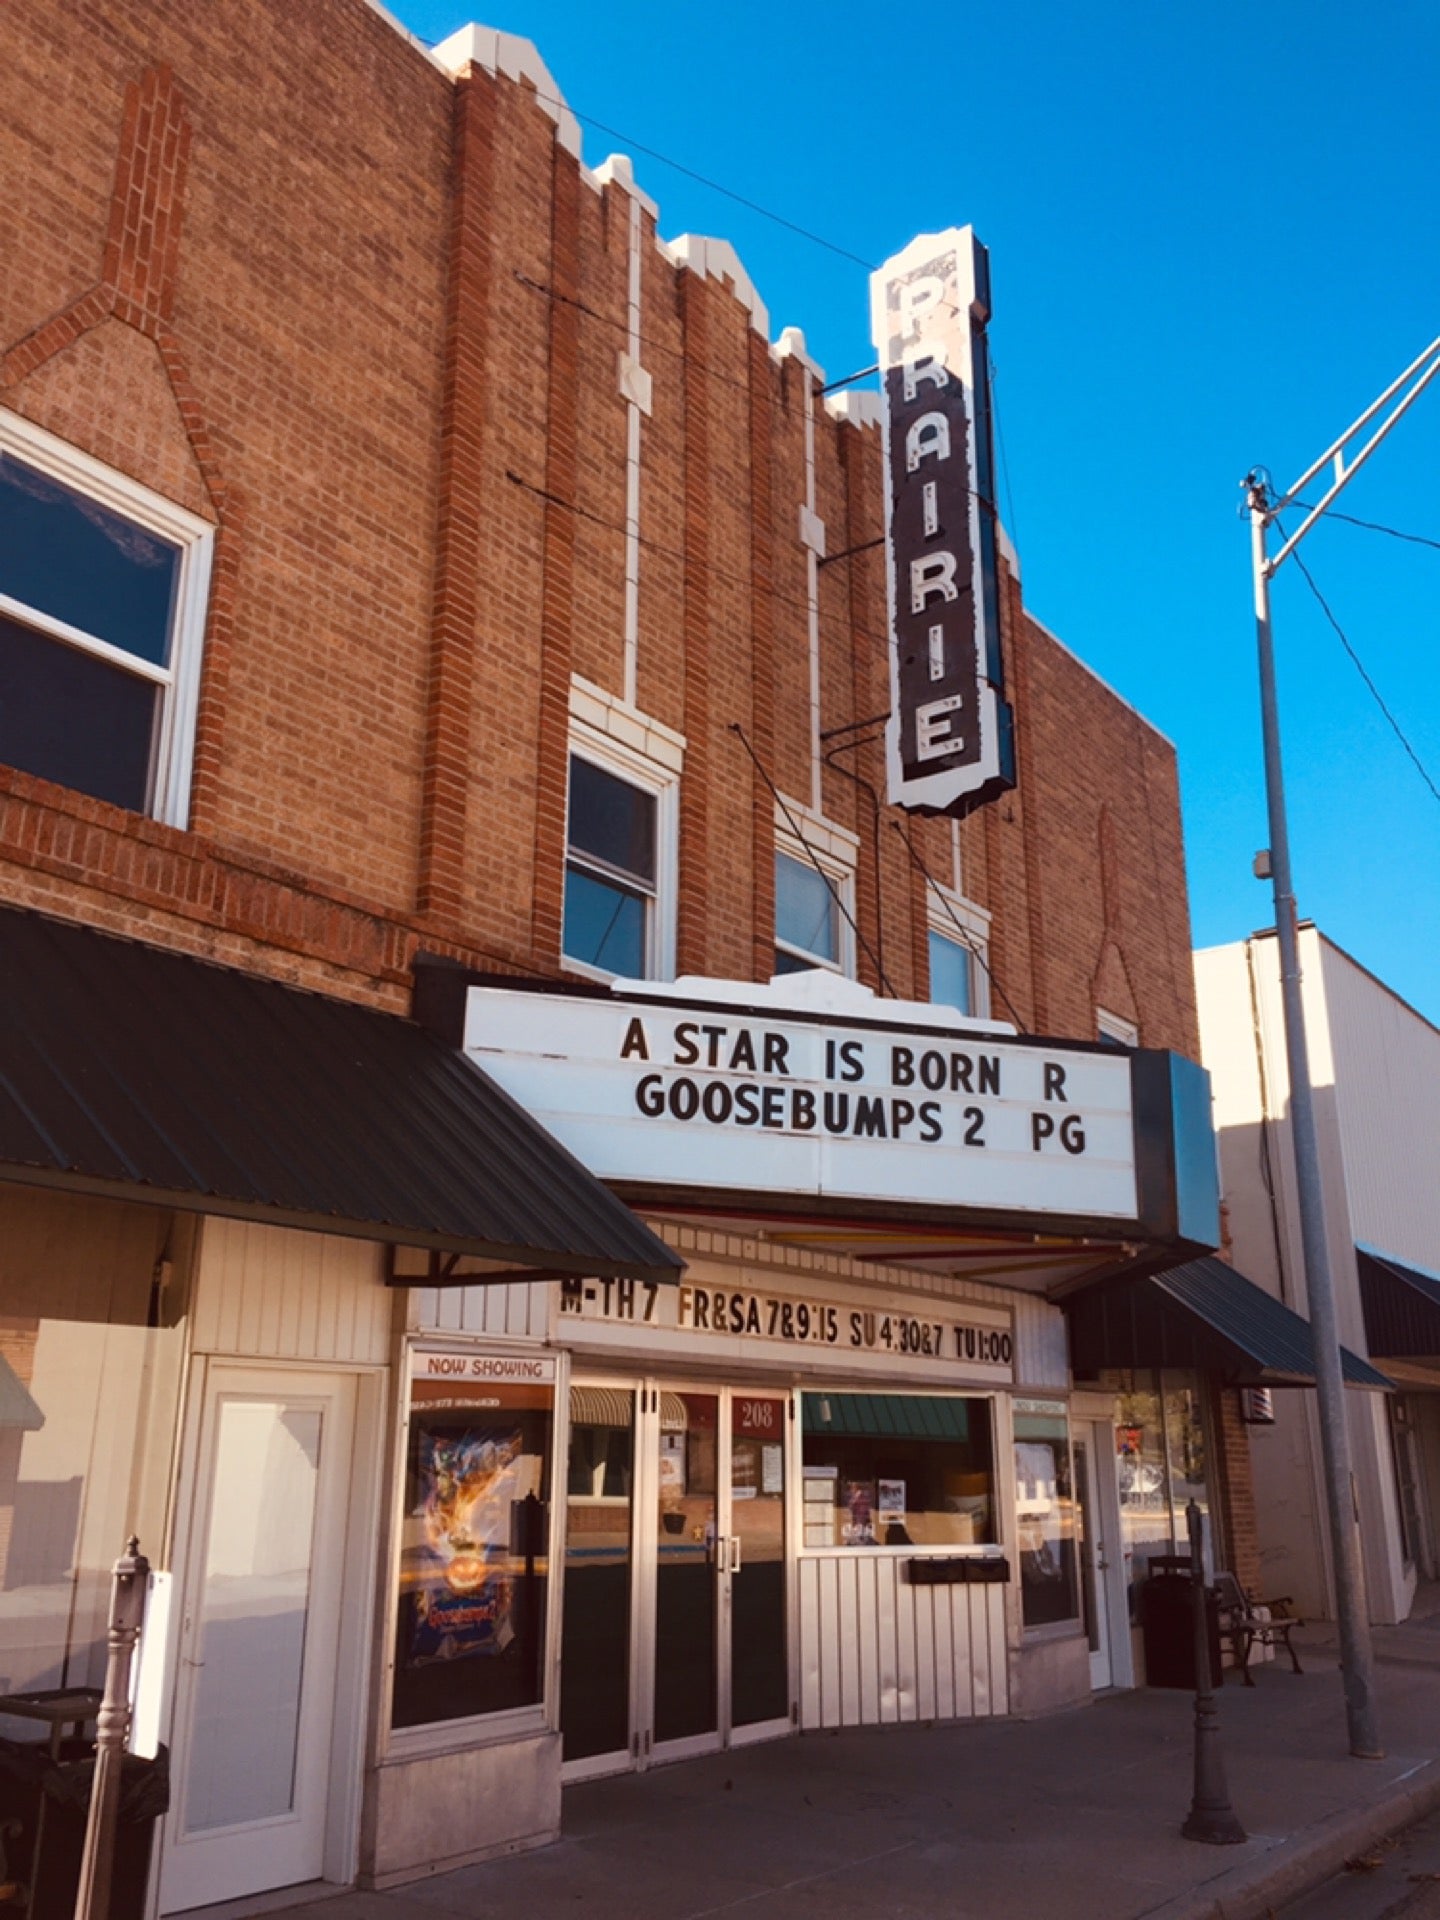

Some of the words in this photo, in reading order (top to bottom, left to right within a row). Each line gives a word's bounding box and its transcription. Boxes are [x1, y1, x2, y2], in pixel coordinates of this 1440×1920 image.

[898, 275, 965, 763] PRAIRIE
[620, 1017, 650, 1061] A
[673, 1022, 790, 1075] STAR
[825, 1040, 865, 1083] IS
[891, 1046, 1001, 1096] BORN
[1043, 1062, 1068, 1103] R
[635, 1073, 943, 1143] GOOSEBUMPS
[963, 1106, 986, 1147] 2
[1031, 1112, 1086, 1155] PG
[427, 1358, 467, 1375] NOW
[471, 1359, 543, 1378] SHOWING
[742, 1400, 773, 1429] 208
